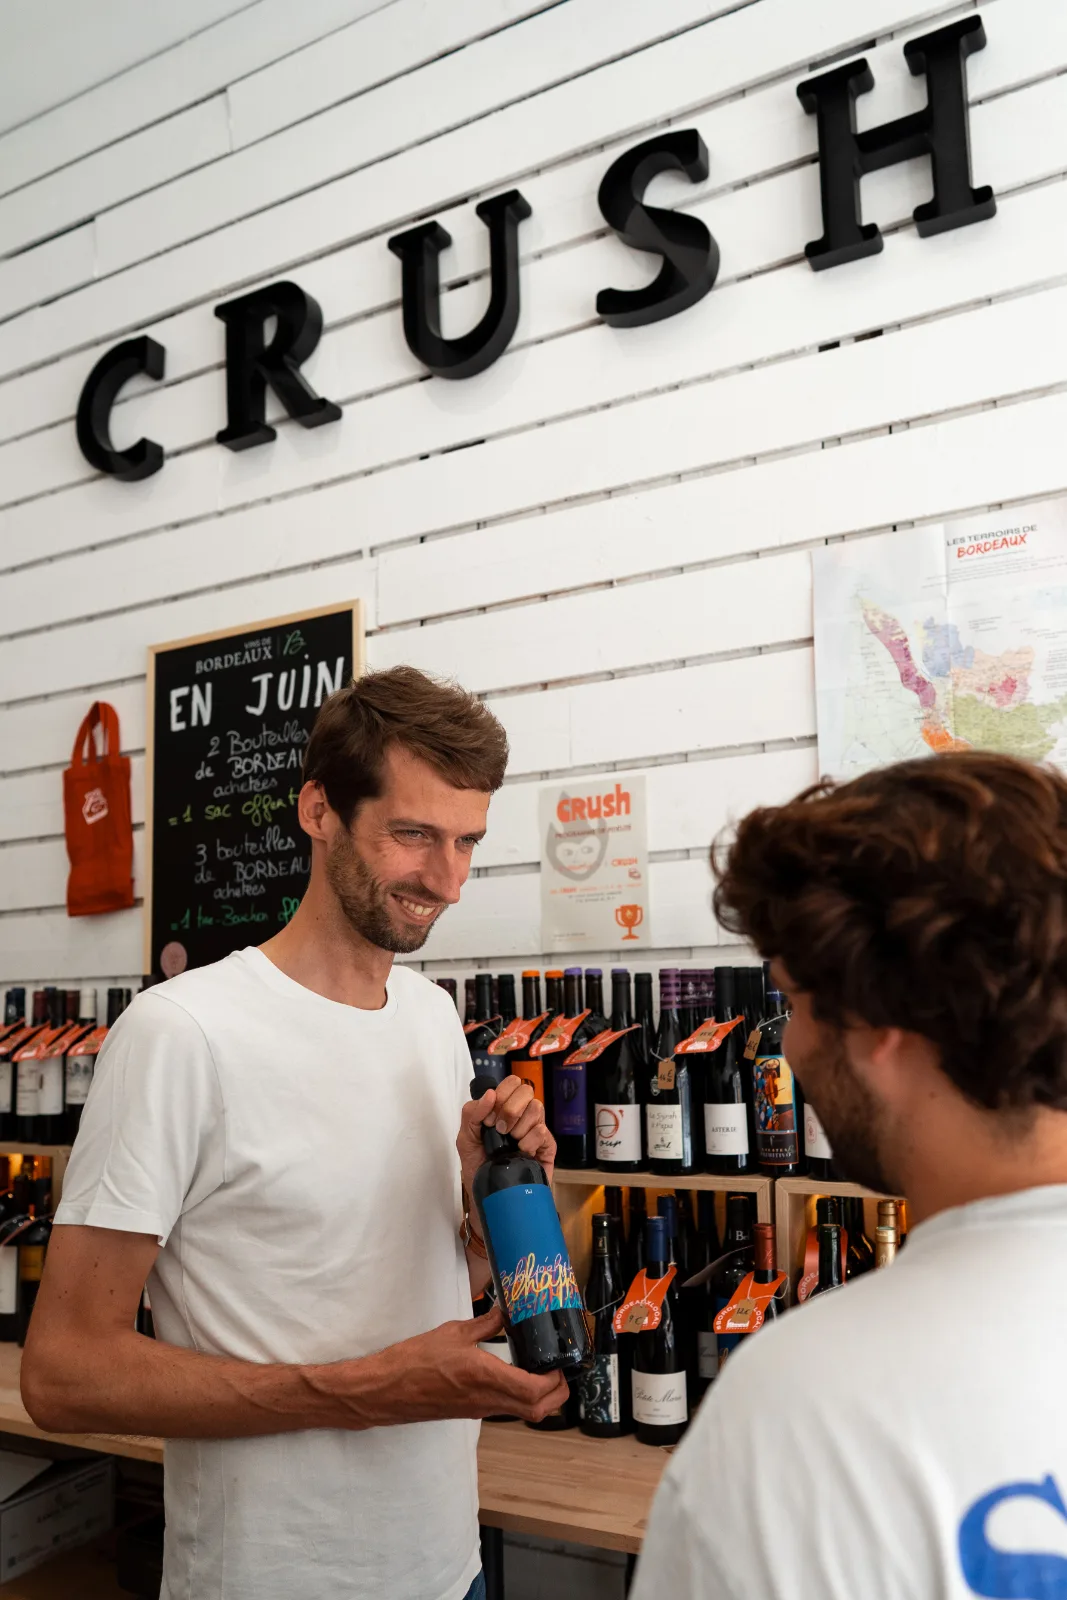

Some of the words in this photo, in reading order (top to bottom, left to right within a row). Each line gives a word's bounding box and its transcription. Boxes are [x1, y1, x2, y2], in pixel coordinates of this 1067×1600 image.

[76, 14, 996, 482] CRUSH
[946, 537, 966, 547] LES
[967, 527, 1021, 542] TERROIRS
[1022, 524, 1038, 533] DE
[957, 533, 1028, 558] BORDEAUX
[195, 646, 273, 674] BORDEAUX
[170, 682, 212, 732] EN
[207, 735, 220, 758] 2
[226, 719, 310, 756] Bouteilles
[195, 761, 215, 780] de
[226, 748, 304, 778] BORDEA
[204, 804, 232, 820] sac
[194, 843, 208, 866] 3
[194, 866, 215, 883] de
[233, 856, 311, 882] BORDEAU
